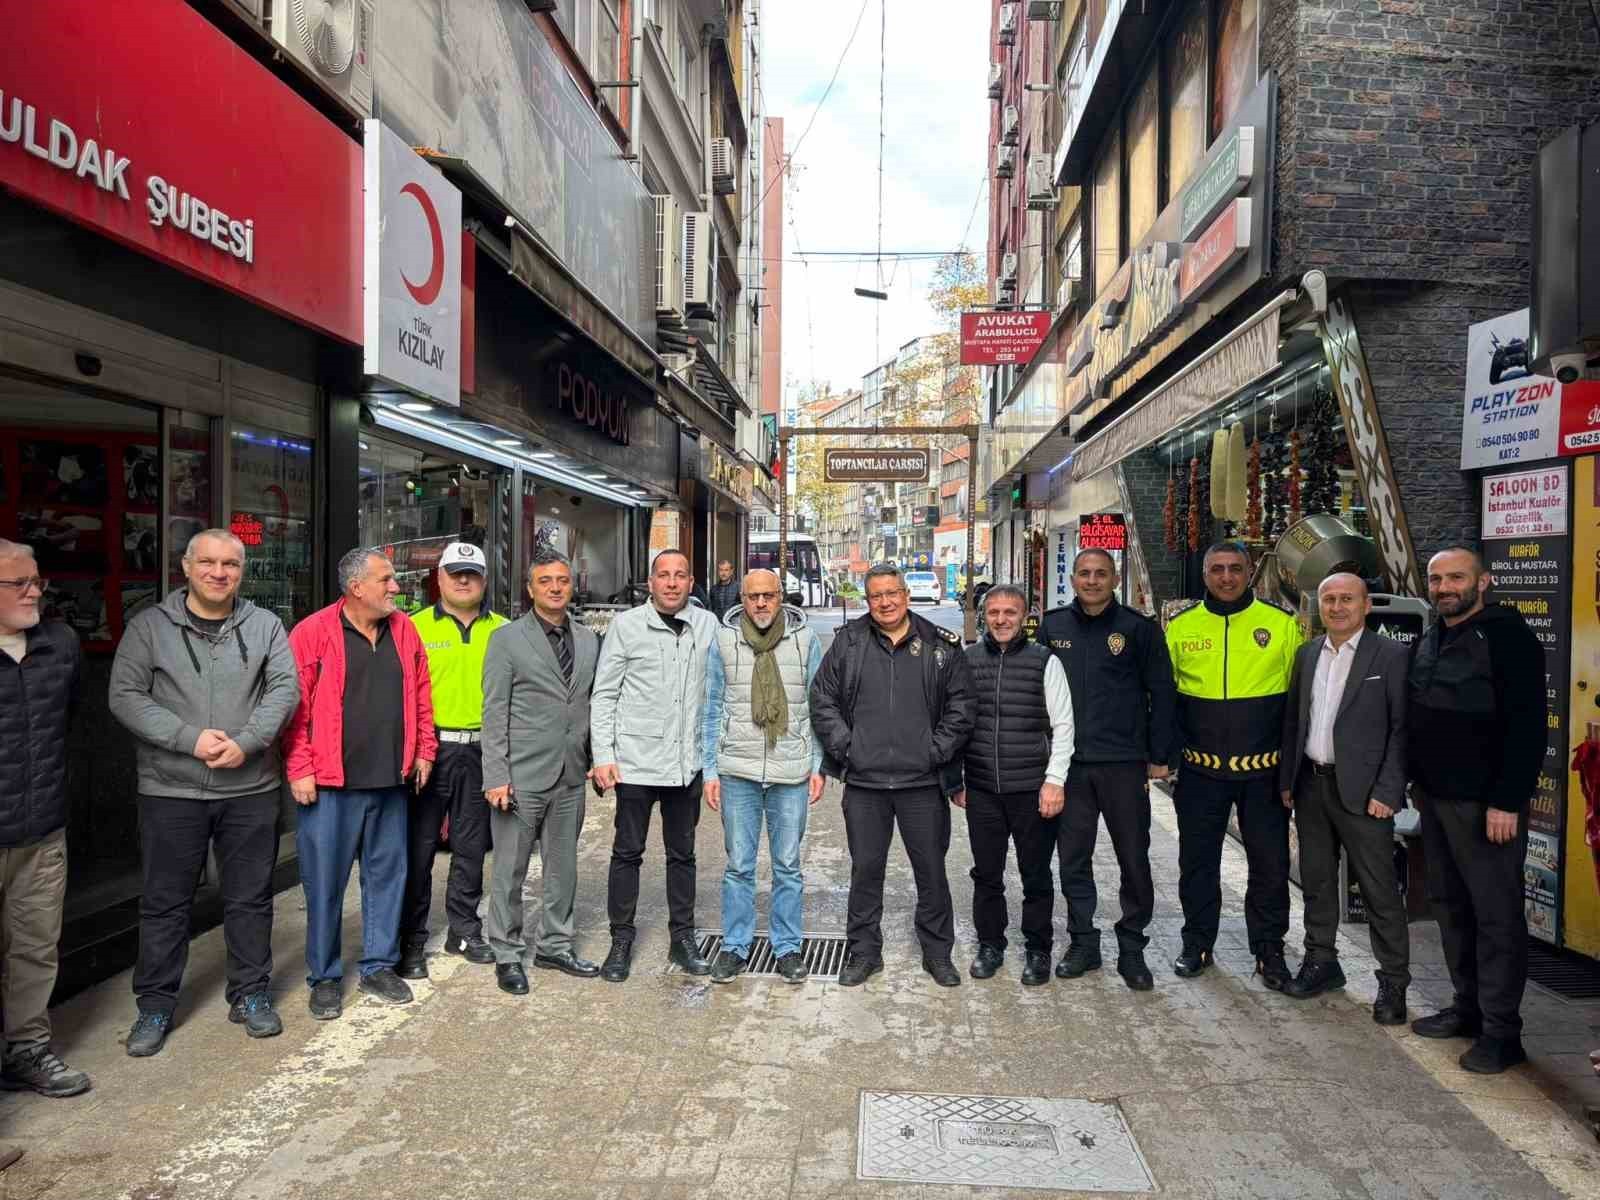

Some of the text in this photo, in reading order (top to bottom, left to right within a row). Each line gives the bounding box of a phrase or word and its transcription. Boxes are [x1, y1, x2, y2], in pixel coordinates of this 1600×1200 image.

[147, 175, 254, 264] ŞUBESİ
[413, 316, 432, 340] TÜRK
[977, 315, 1034, 326] AVUKAT
[975, 328, 1038, 337] ARABULUCU
[398, 327, 445, 371] KIZILAY
[1482, 403, 1540, 424] STATION
[830, 458, 923, 472] TOPTANCILAR ÇARŞISI
[1489, 477, 1538, 497] SALOON
[1080, 523, 1125, 537] BİLGİSAYAR
[1491, 560, 1513, 570] BİROL
[1521, 560, 1558, 570] MUSTAFA
